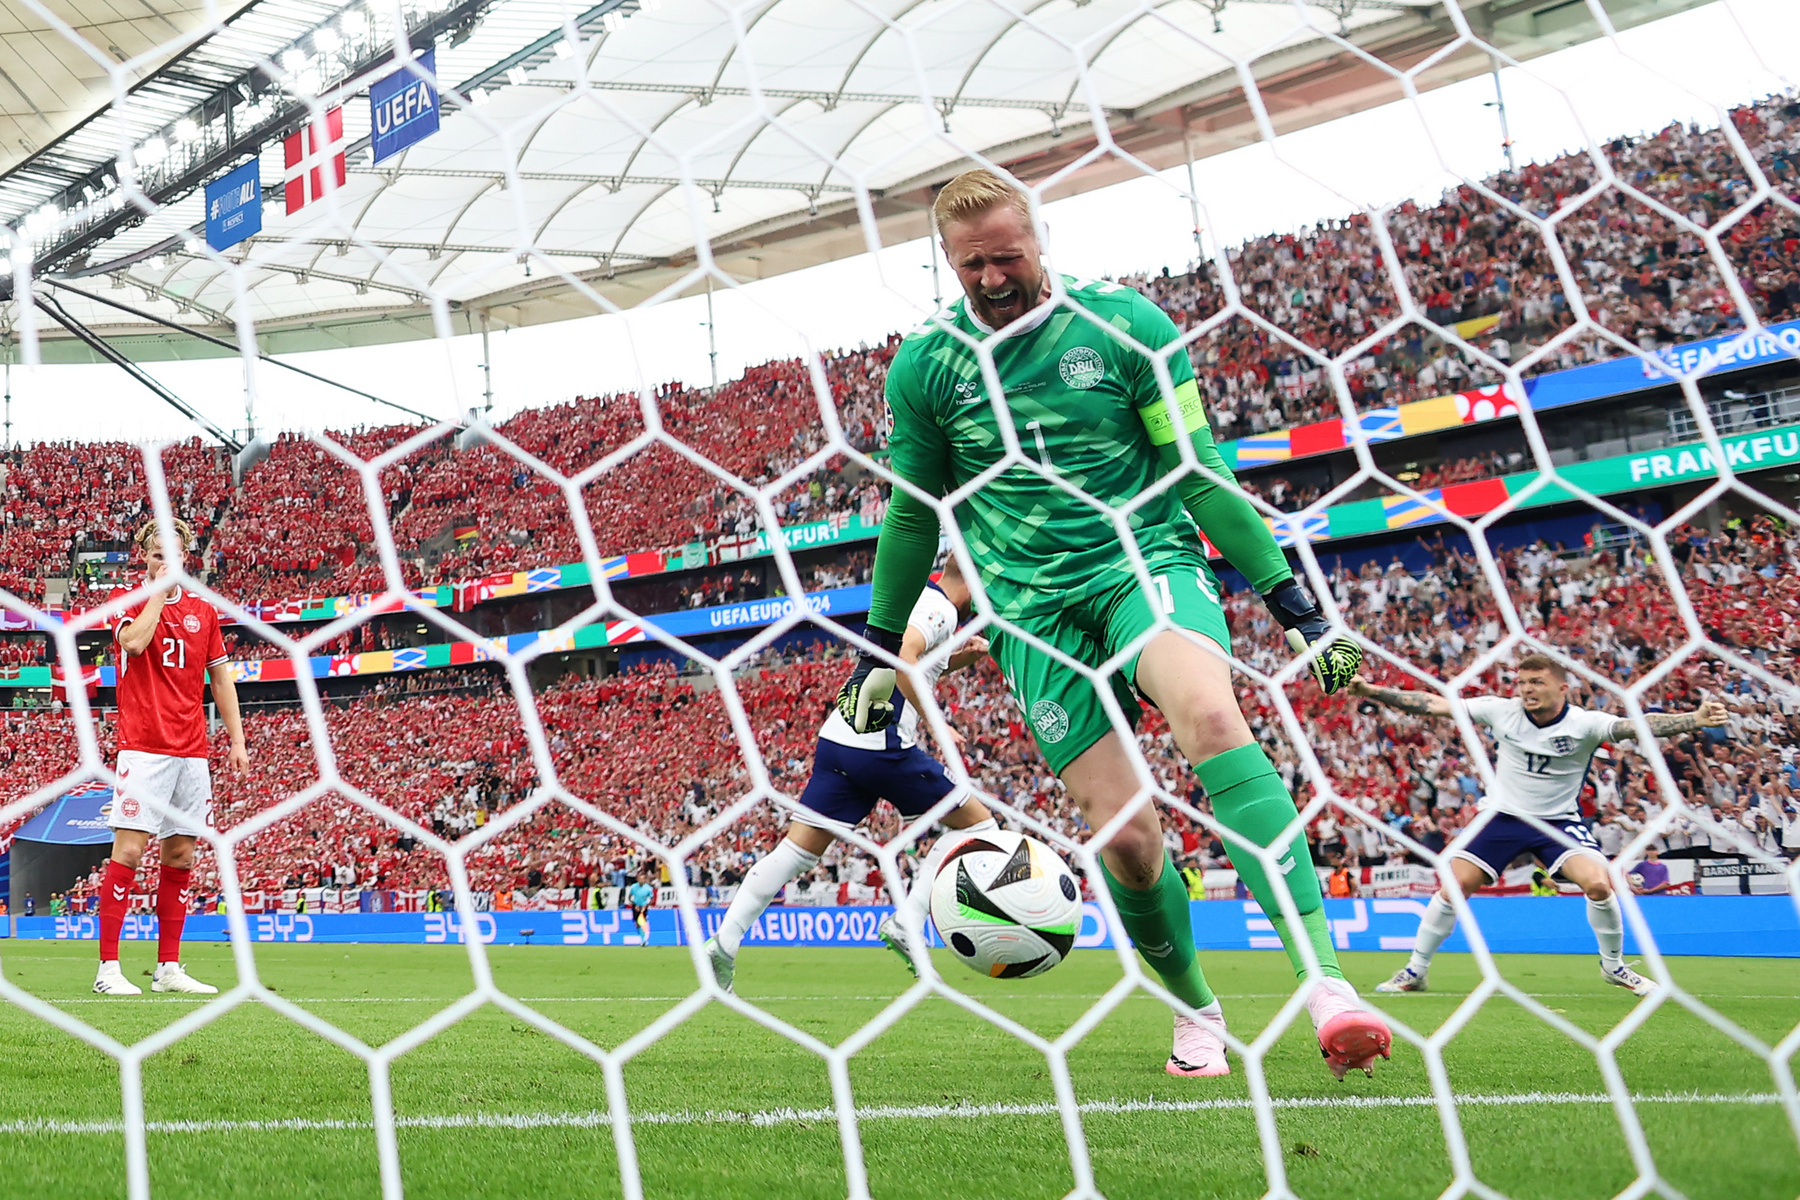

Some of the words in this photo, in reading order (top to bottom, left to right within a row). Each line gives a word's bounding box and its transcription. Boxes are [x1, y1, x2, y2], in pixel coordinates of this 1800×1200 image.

[375, 81, 432, 135] UEFA
[1068, 360, 1096, 375] DBU
[1025, 420, 1054, 473] 1
[1152, 574, 1176, 614] 1
[162, 637, 185, 669] 21
[1524, 752, 1550, 774] 12
[1703, 864, 1753, 877] BARNSLEY
